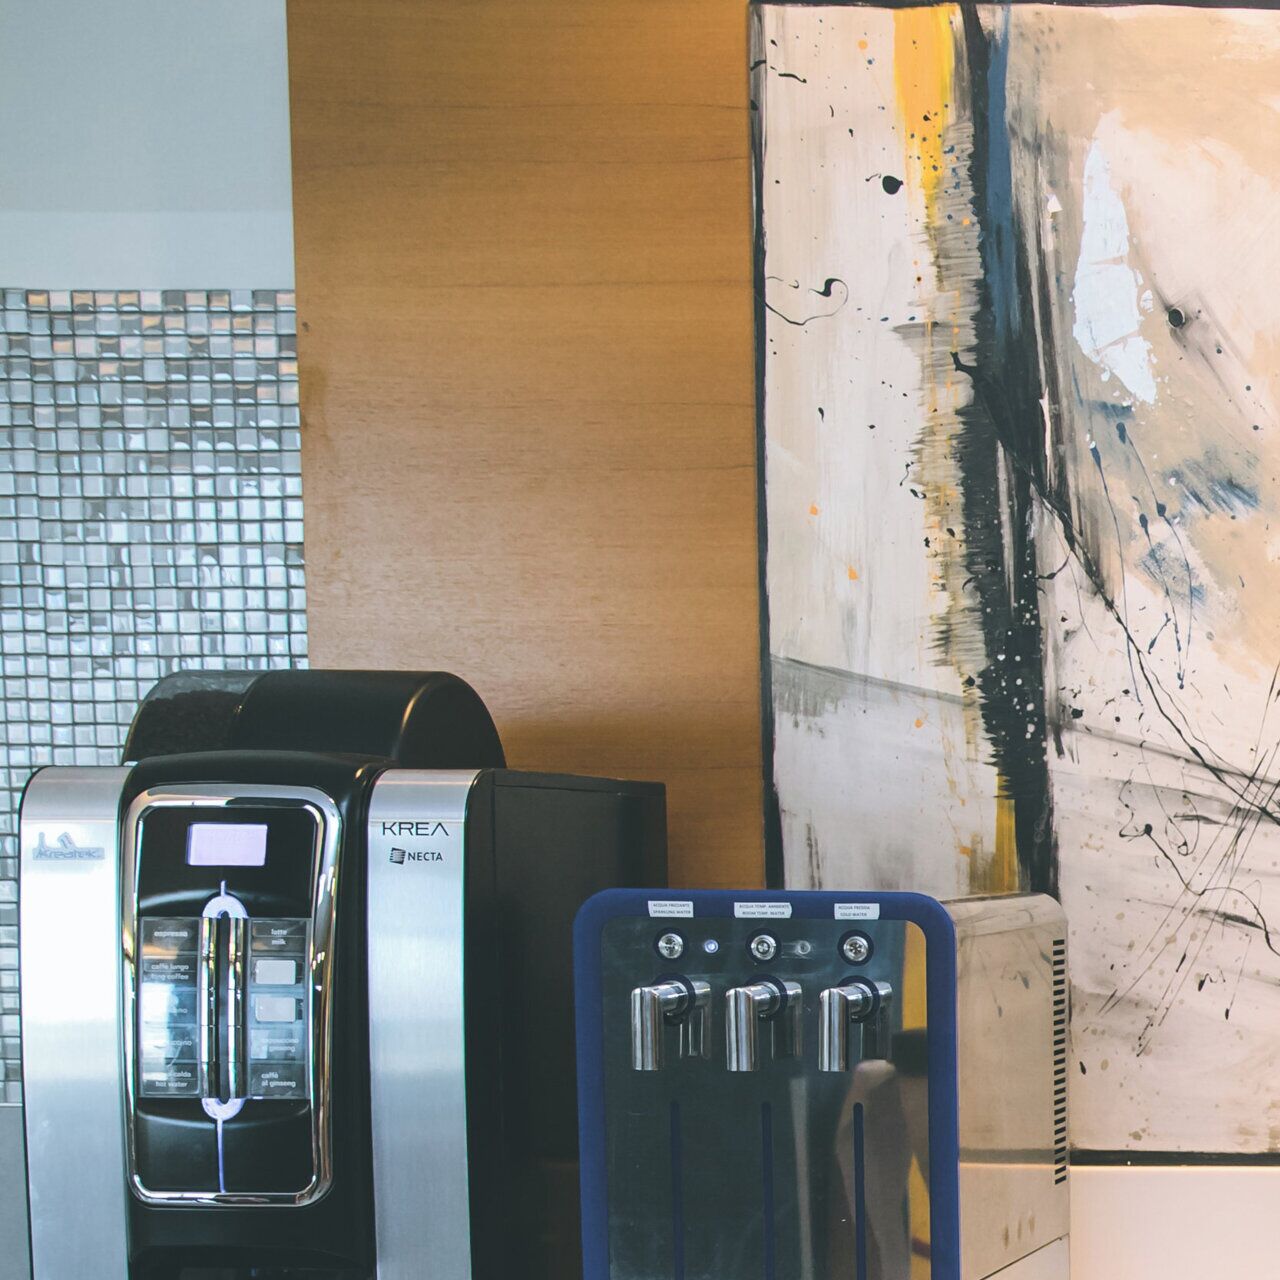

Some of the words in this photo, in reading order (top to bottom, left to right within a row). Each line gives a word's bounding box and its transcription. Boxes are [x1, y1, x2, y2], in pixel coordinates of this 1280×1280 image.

[383, 821, 449, 836] KREA
[408, 852, 443, 861] NECTA
[170, 963, 189, 972] lungo
